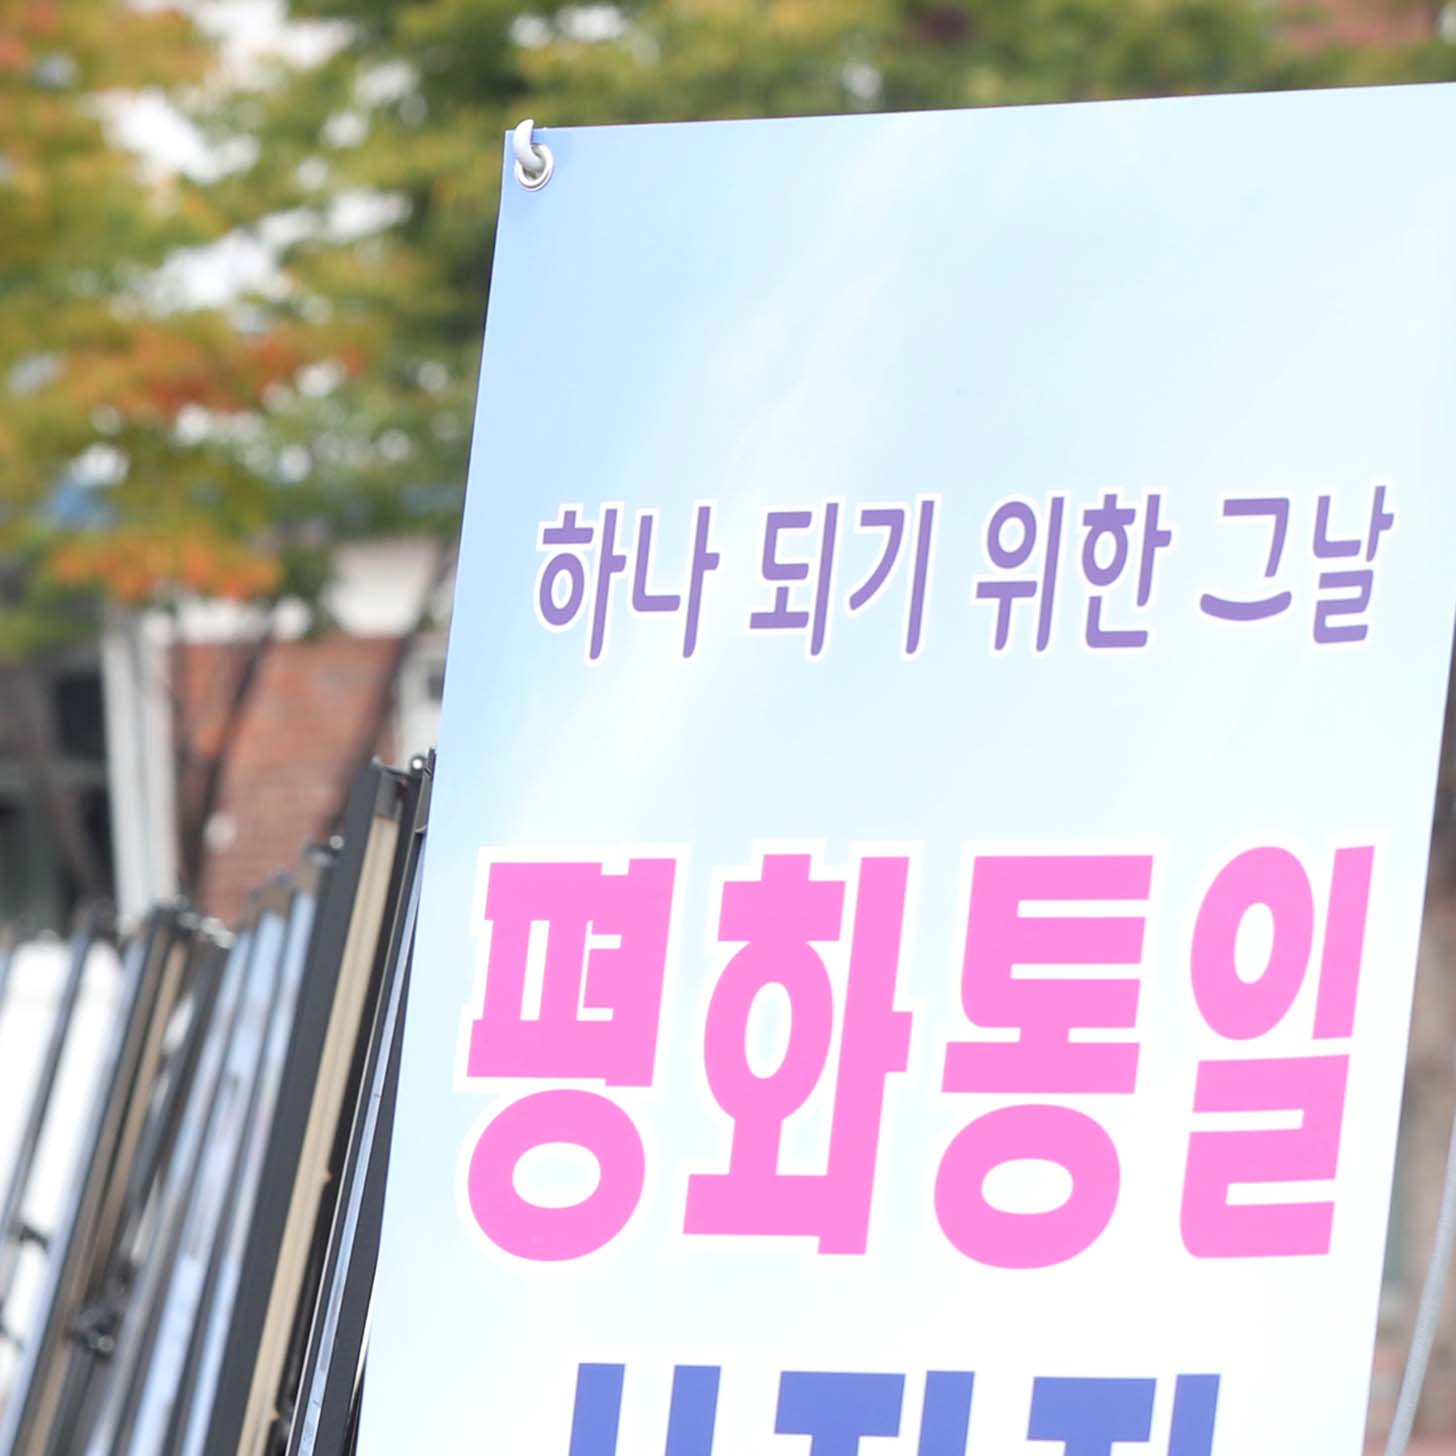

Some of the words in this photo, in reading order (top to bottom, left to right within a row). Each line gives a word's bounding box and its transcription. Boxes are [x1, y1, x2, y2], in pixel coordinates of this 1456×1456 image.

[538, 506, 721, 661] 하나
[748, 500, 936, 656] 되기
[974, 493, 1172, 652] 위한
[1199, 485, 1394, 645] 그날
[466, 845, 1376, 1270] 평화통일
